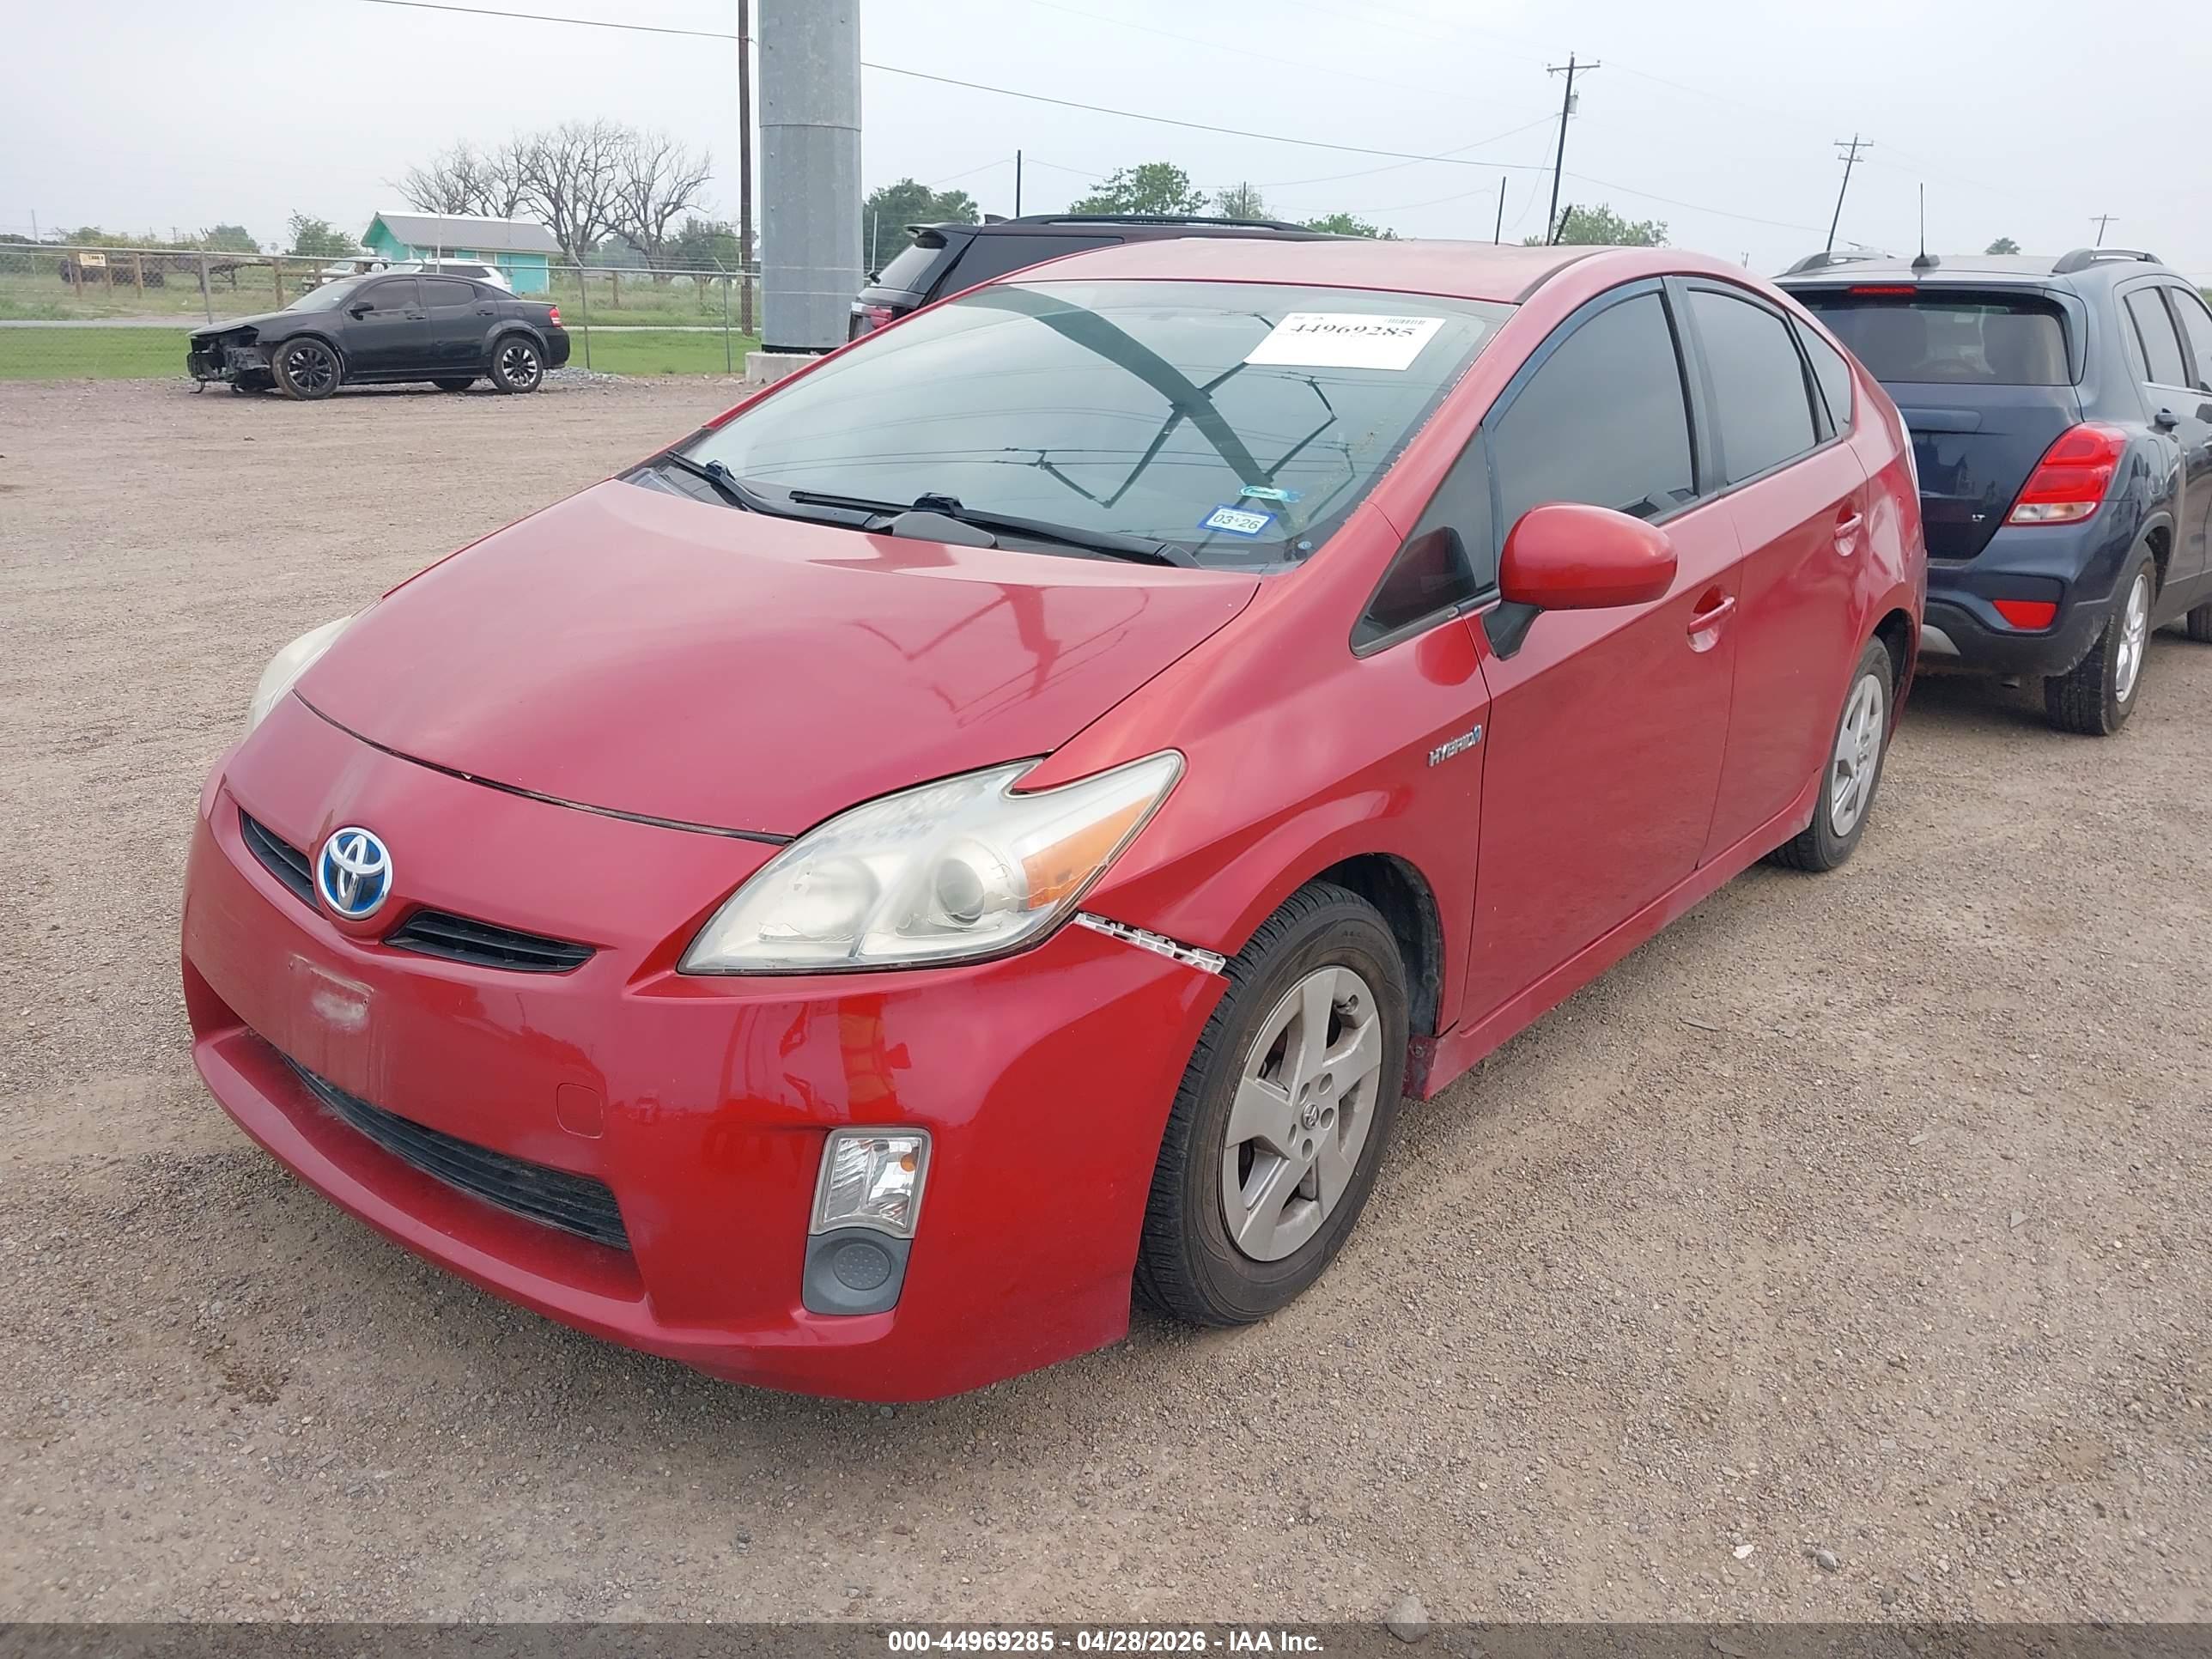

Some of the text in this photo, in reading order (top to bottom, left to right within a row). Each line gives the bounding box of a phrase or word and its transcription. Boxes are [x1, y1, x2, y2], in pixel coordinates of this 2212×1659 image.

[1291, 324, 1416, 337] 44969285
[1213, 514, 1235, 525] 03
[1237, 518, 1261, 530] 26
[1972, 514, 1986, 522] LT
[1428, 729, 1477, 767] HYBRID
